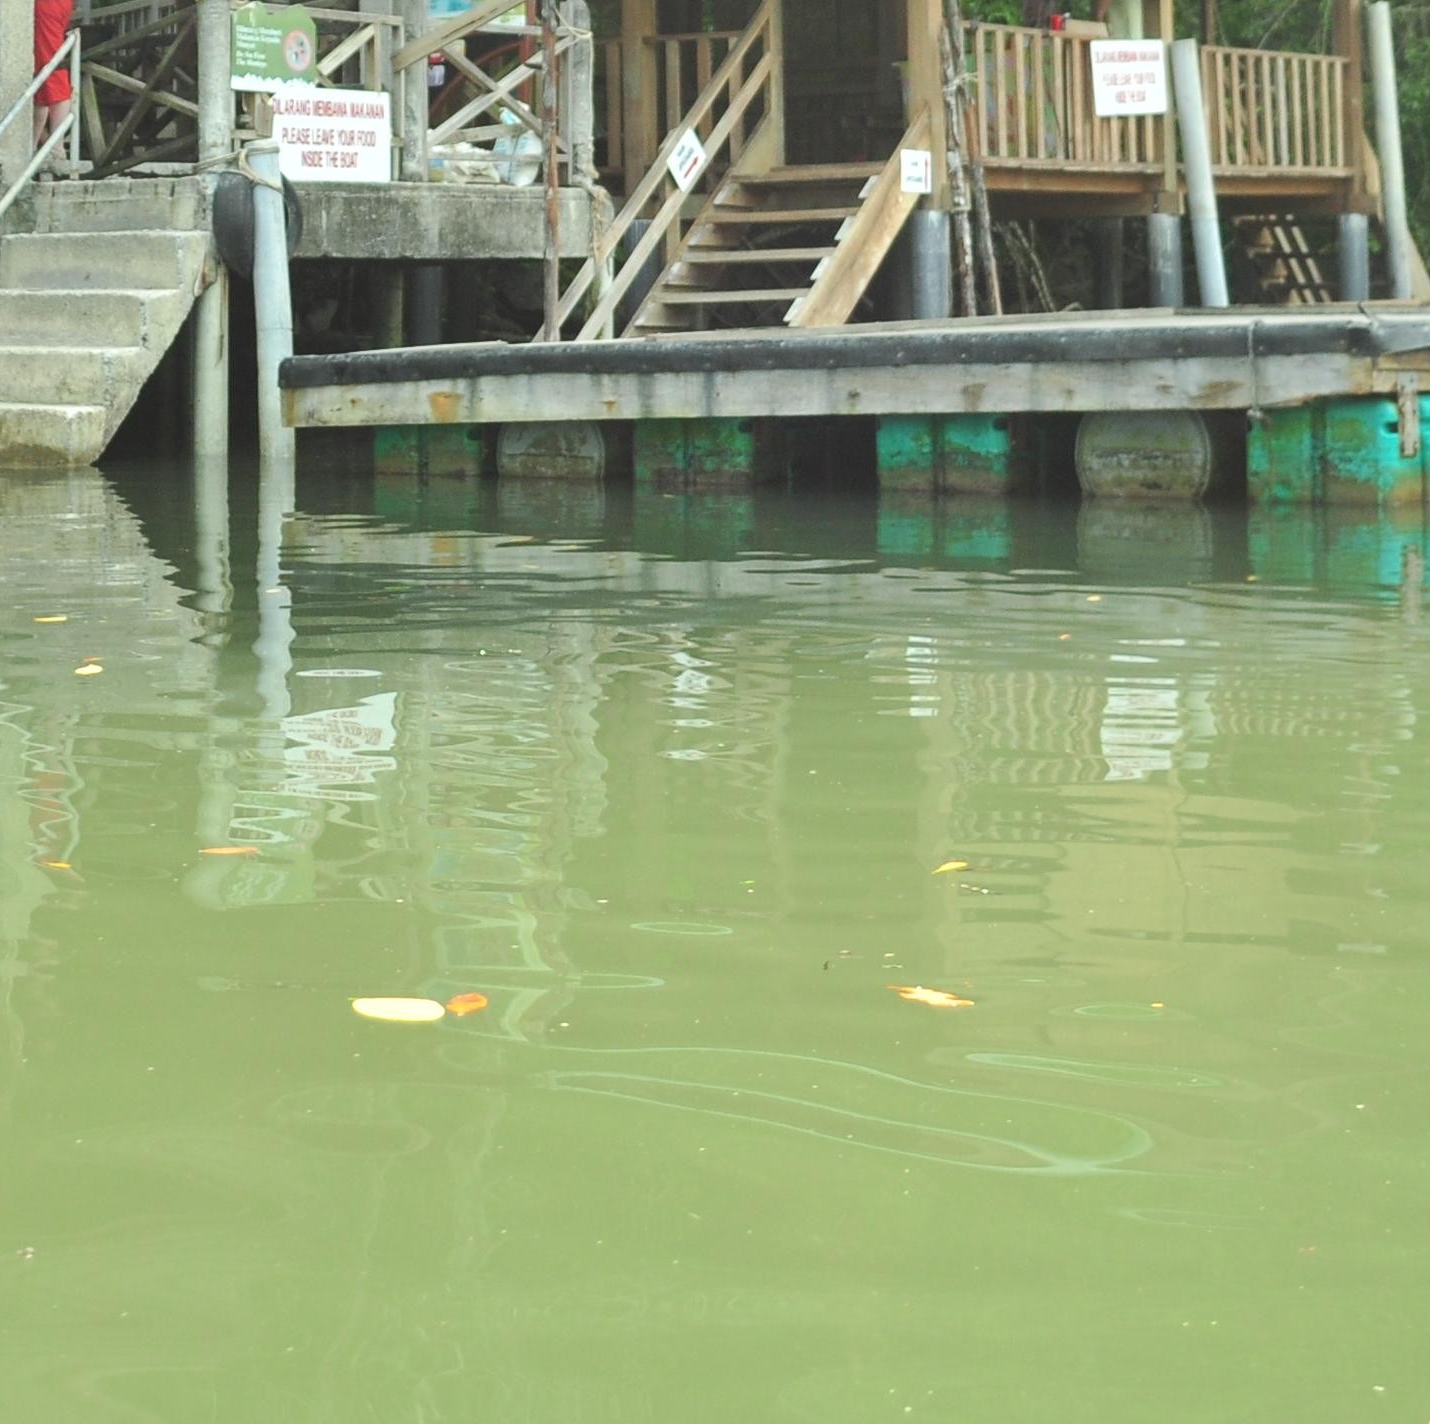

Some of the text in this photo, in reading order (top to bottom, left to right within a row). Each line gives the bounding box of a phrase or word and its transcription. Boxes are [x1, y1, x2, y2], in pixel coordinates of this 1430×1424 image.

[282, 127, 376, 147] PLEASE LEAVE YOUR FOOD
[301, 151, 358, 168] INSIDE THE BOAT
